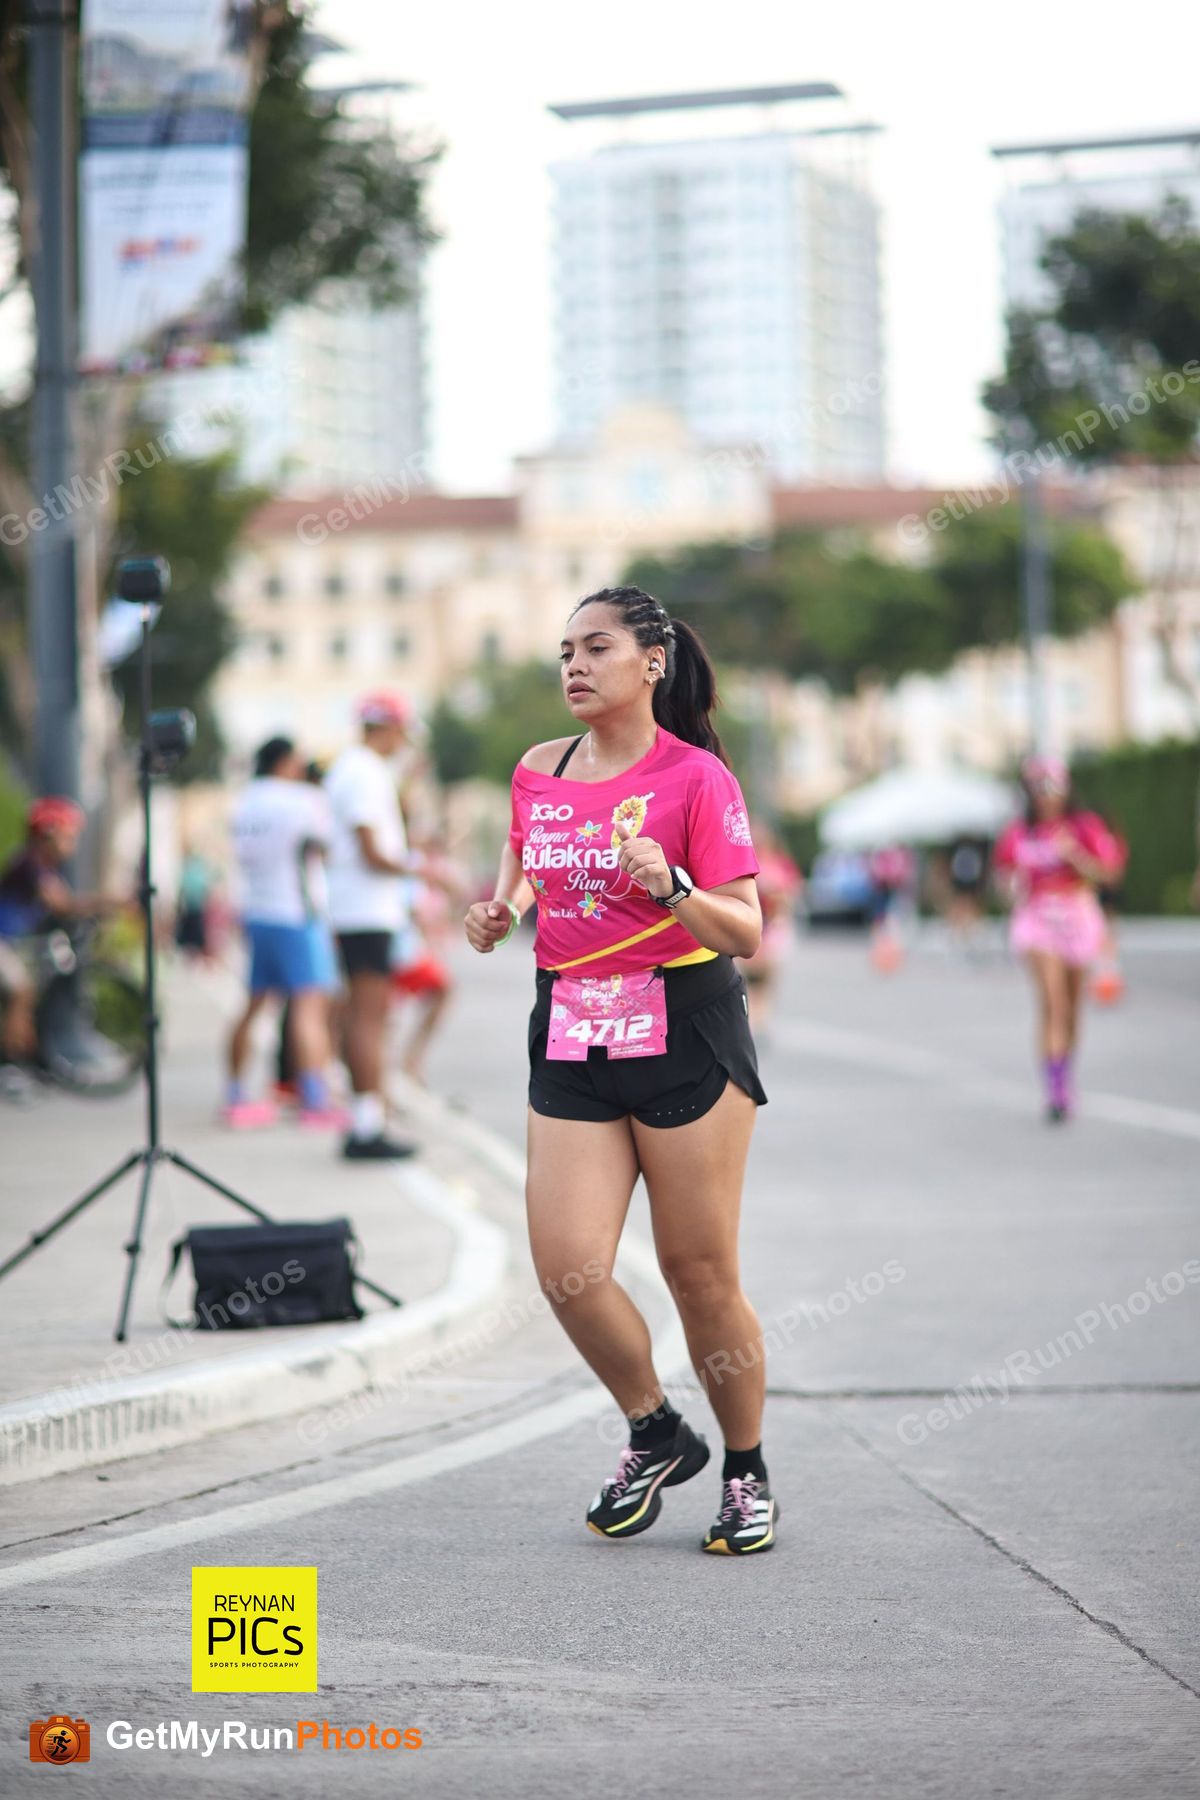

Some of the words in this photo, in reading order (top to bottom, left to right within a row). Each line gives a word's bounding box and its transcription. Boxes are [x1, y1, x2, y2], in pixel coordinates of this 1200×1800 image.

[530, 803, 574, 821] 2GO
[522, 844, 619, 870] Bulakna
[564, 869, 608, 891] Run
[565, 1014, 653, 1044] 4712
